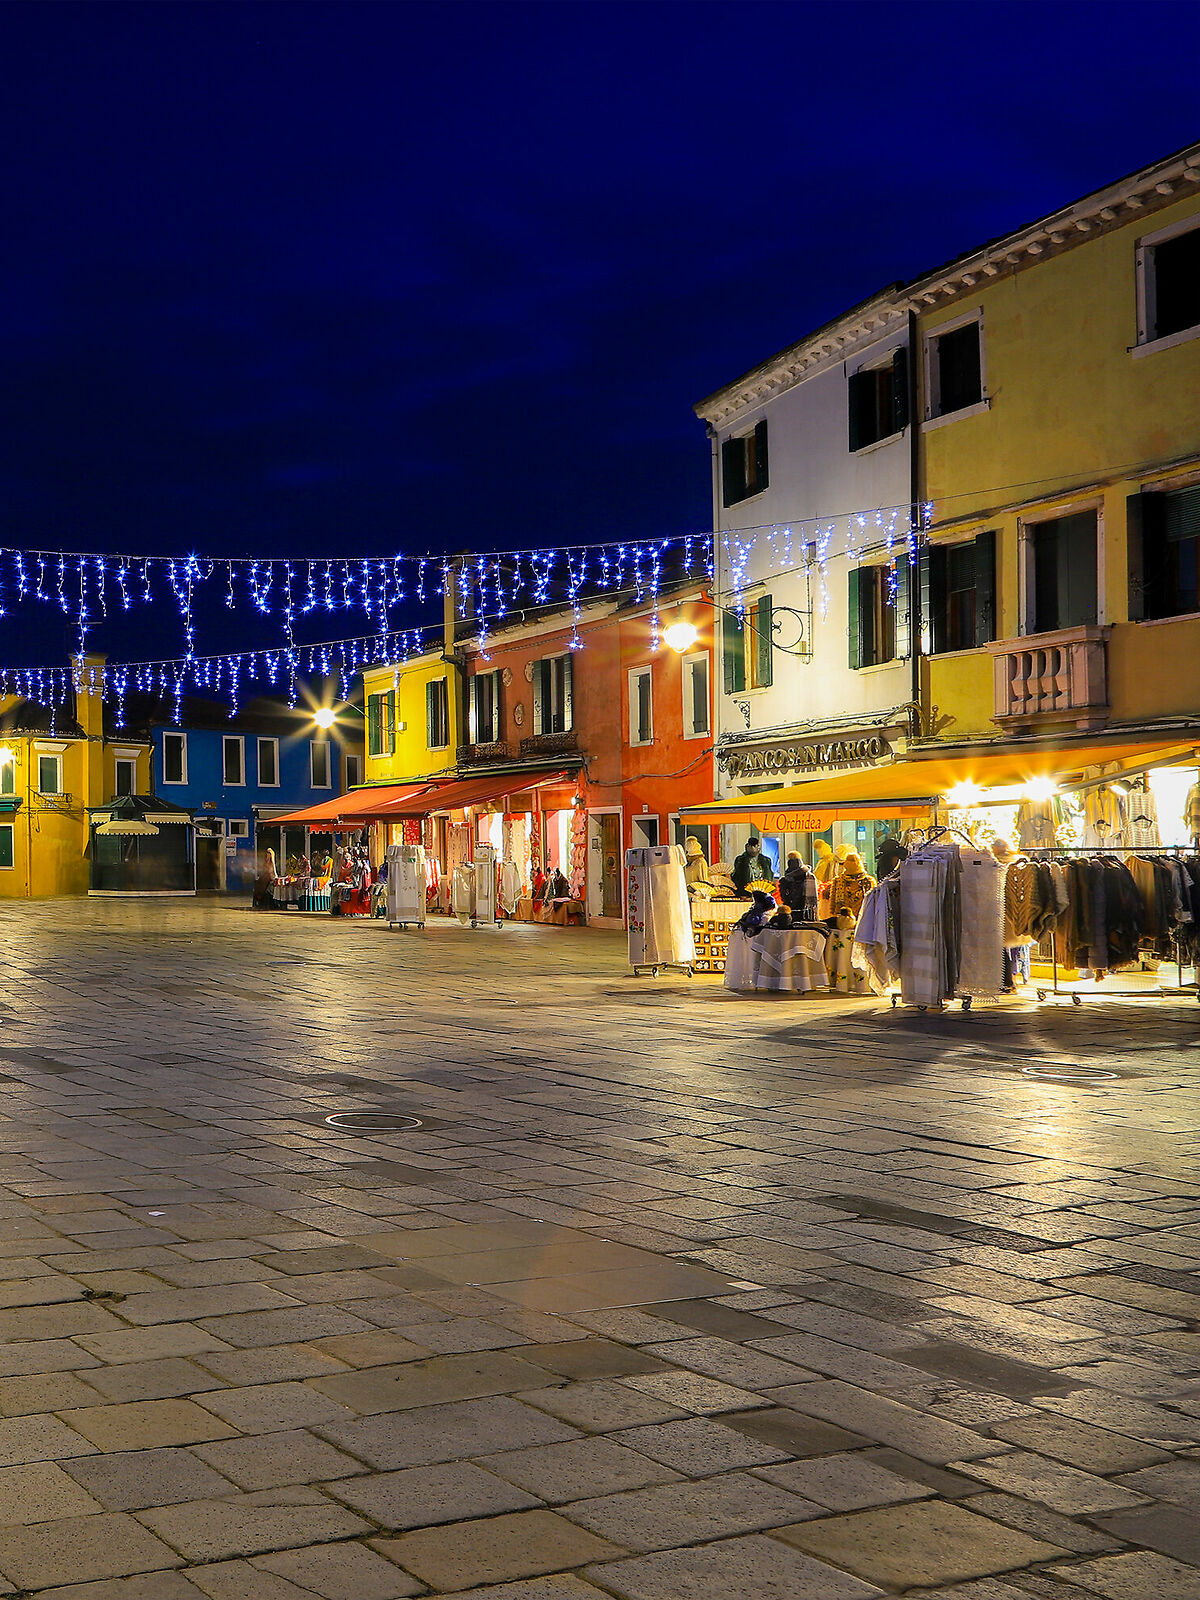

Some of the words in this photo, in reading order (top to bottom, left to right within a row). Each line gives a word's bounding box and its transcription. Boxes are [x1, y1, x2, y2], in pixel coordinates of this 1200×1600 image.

[787, 743, 818, 767] SAN
[819, 736, 882, 763] MARCO
[762, 813, 822, 831] L'Orchidea
